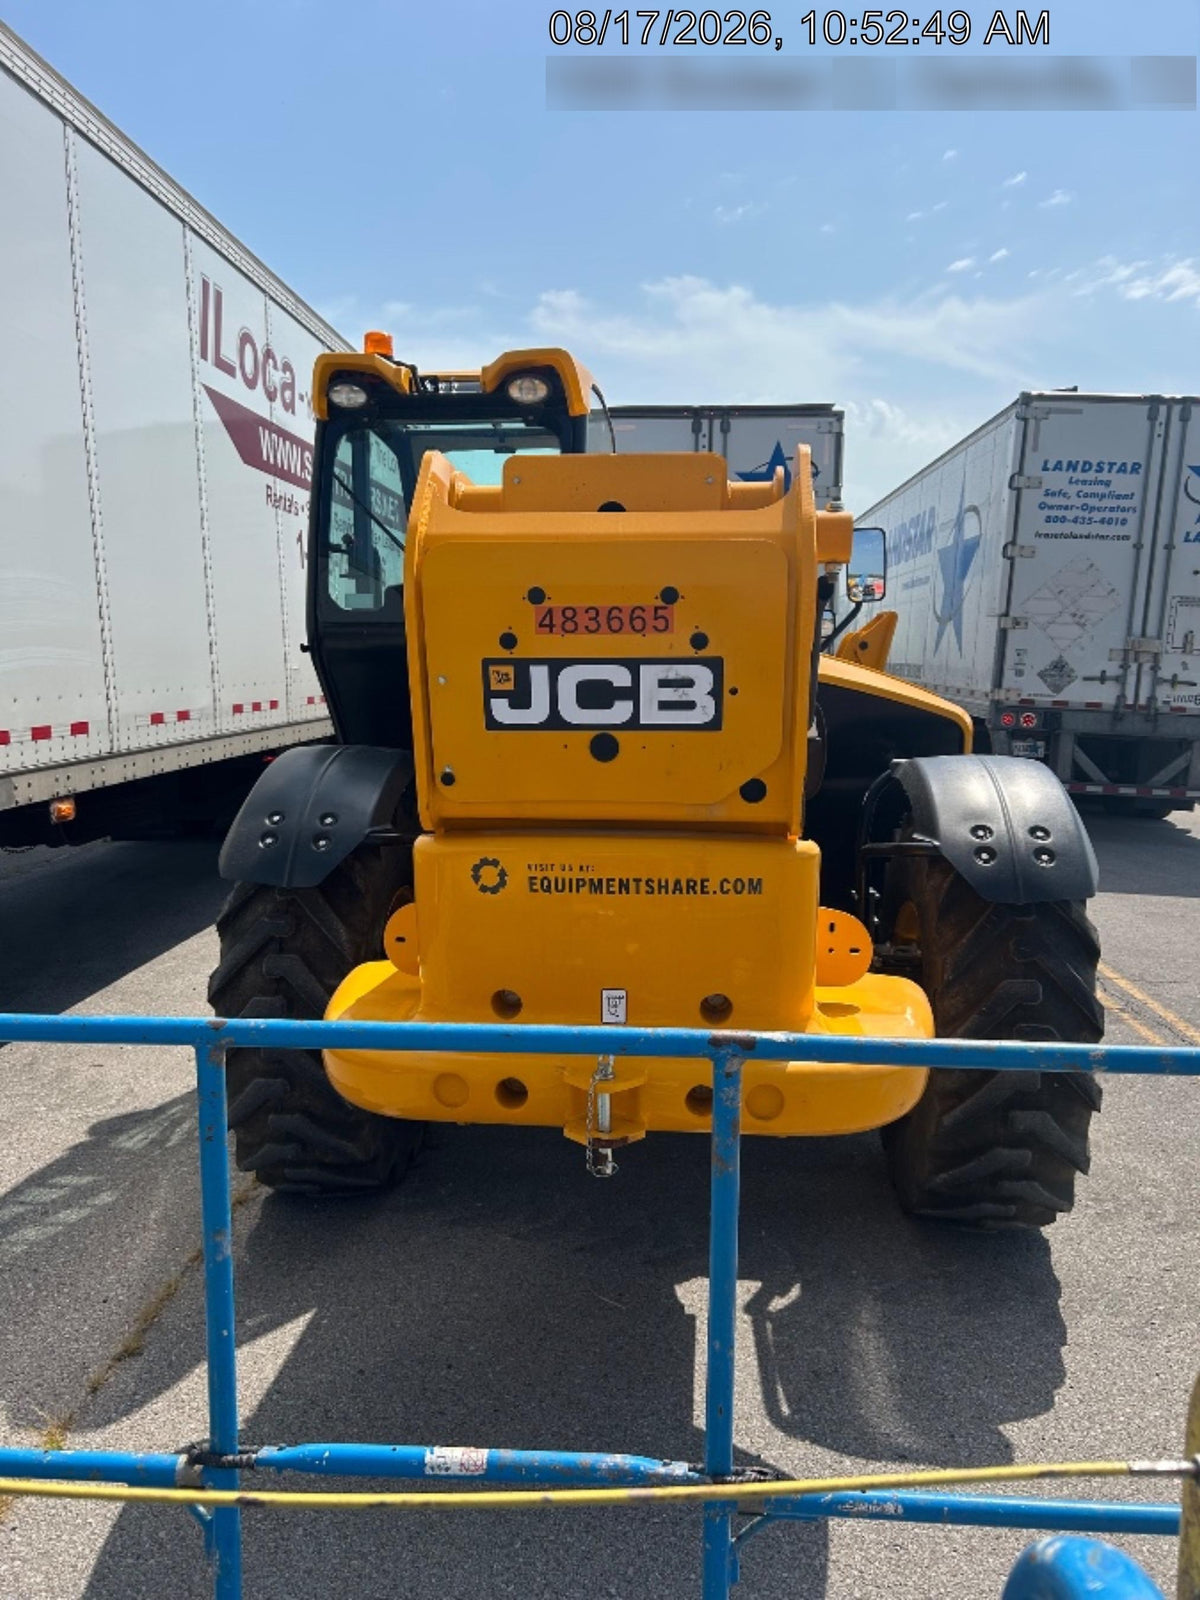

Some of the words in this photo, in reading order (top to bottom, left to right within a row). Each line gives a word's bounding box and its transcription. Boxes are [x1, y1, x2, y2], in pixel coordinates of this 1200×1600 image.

[1041, 459, 1142, 475] LANDSTAR
[1068, 476, 1112, 488] Leasing
[1043, 488, 1072, 500] Safe,
[1076, 490, 1135, 502] Compliant
[1038, 501, 1137, 514] Owner-Operators
[538, 606, 671, 634] 483665
[489, 664, 716, 725] JCB
[527, 863, 555, 872] VISIT
[560, 864, 574, 872] US
[528, 876, 763, 895] EQUIPMENTSHARE.COM
